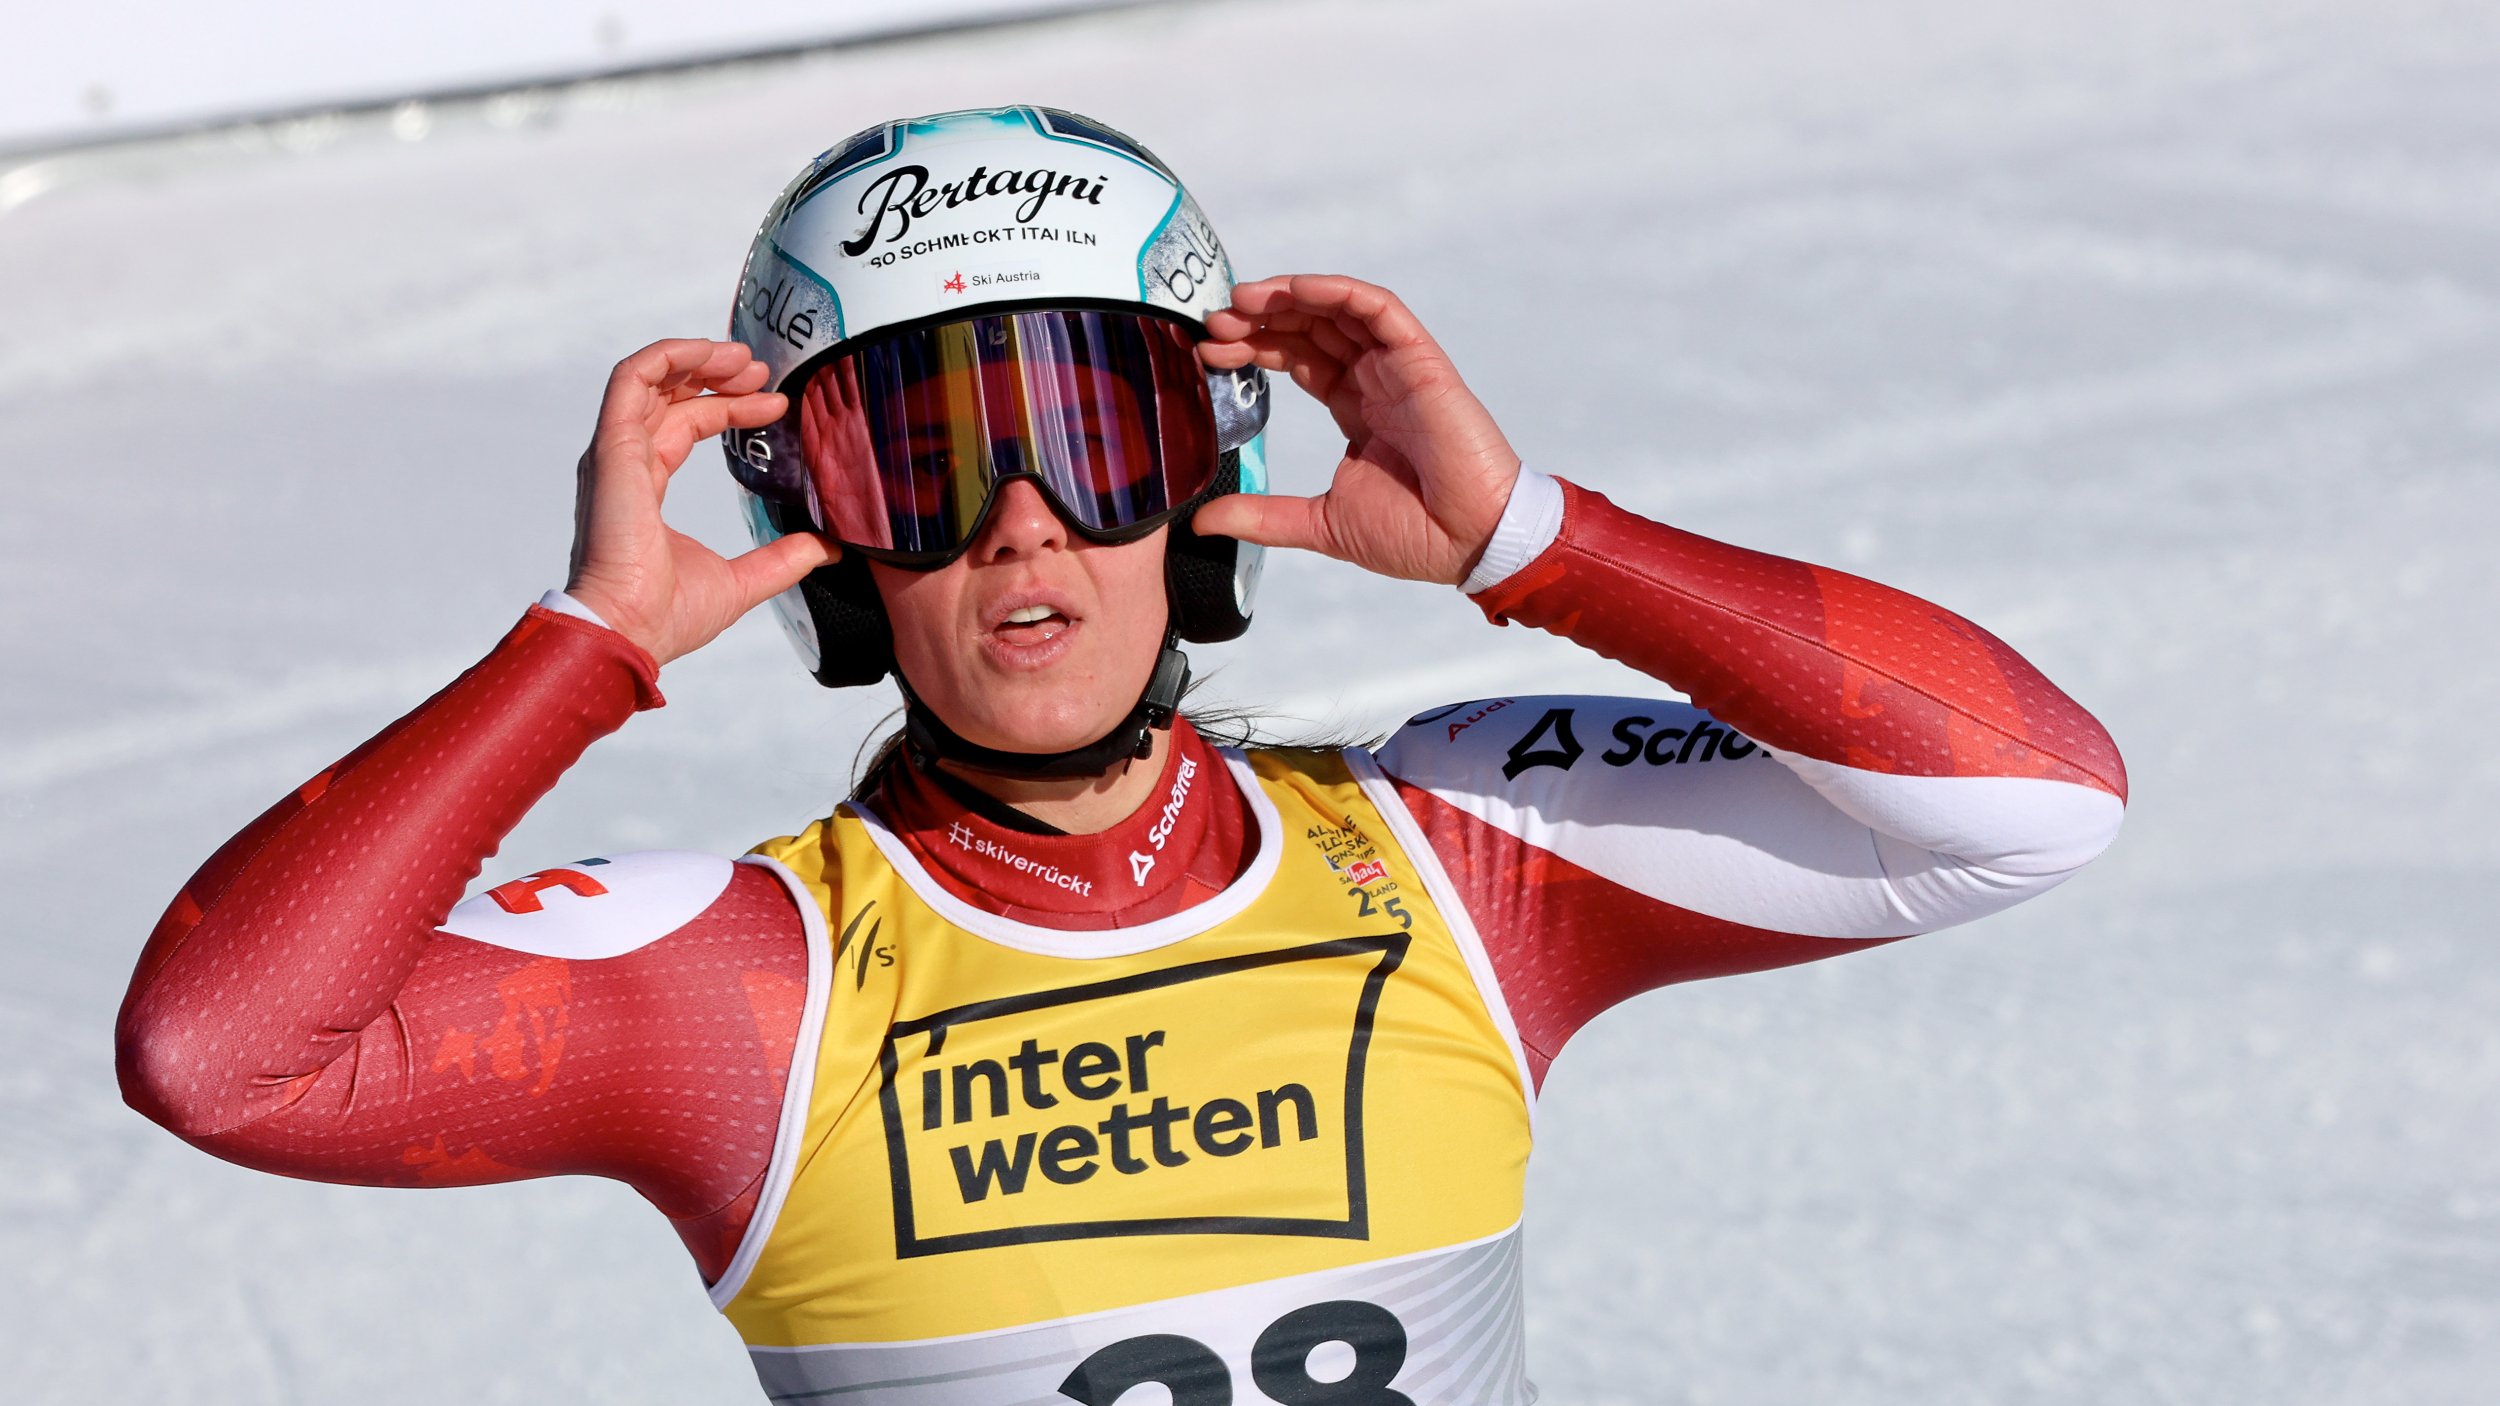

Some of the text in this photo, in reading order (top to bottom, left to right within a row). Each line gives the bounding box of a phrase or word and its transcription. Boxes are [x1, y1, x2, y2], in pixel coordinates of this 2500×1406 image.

[840, 165, 1108, 257] Bertagni
[870, 252, 896, 268] SO
[971, 270, 1040, 287] Ski Austria
[1601, 715, 1774, 767] Scho
[1148, 753, 1198, 851] Schöffel
[922, 1026, 1166, 1131] inter
[949, 1082, 1319, 1205] wetten
